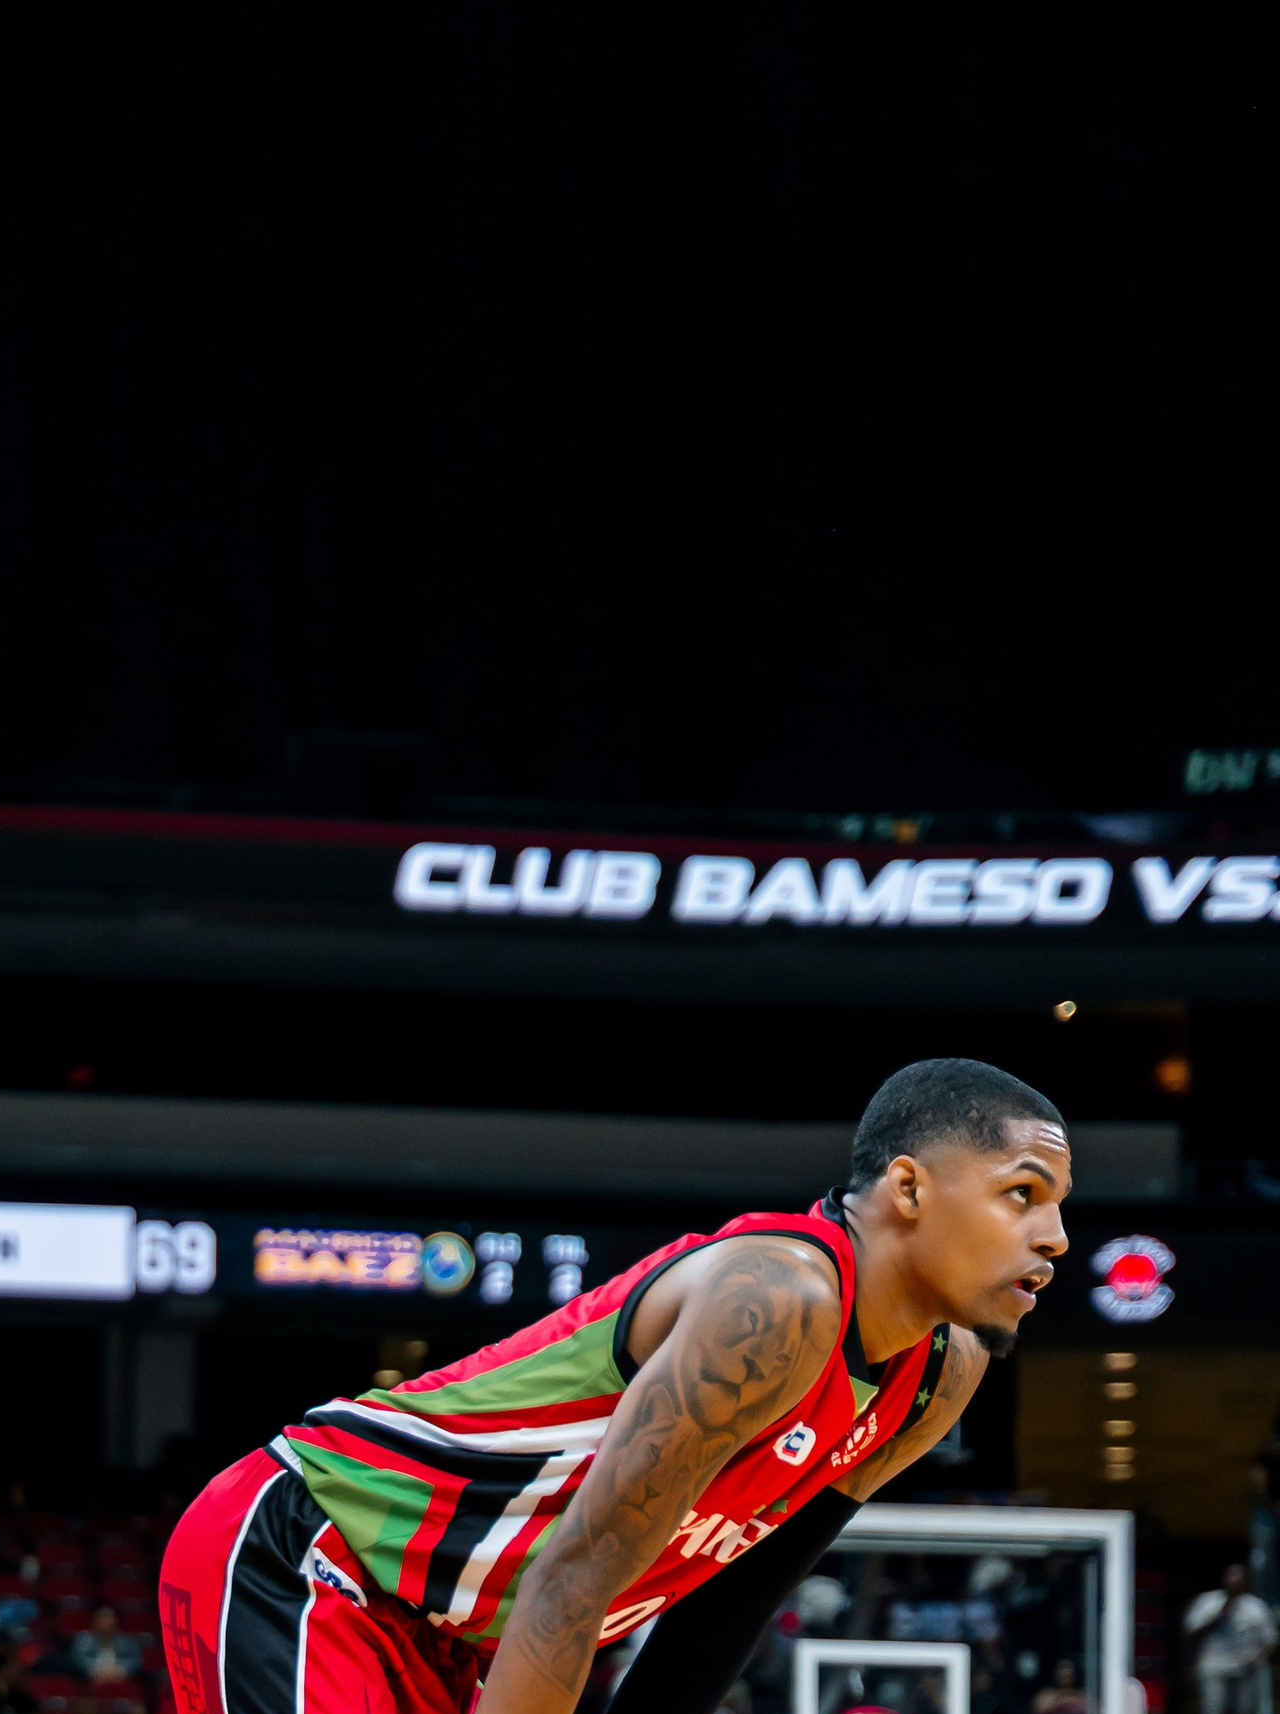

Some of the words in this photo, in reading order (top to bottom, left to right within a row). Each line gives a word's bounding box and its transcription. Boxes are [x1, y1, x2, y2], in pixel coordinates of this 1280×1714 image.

[394, 841, 662, 918] CLUB
[669, 855, 1114, 926] BAMESO
[134, 1220, 217, 1295] 69
